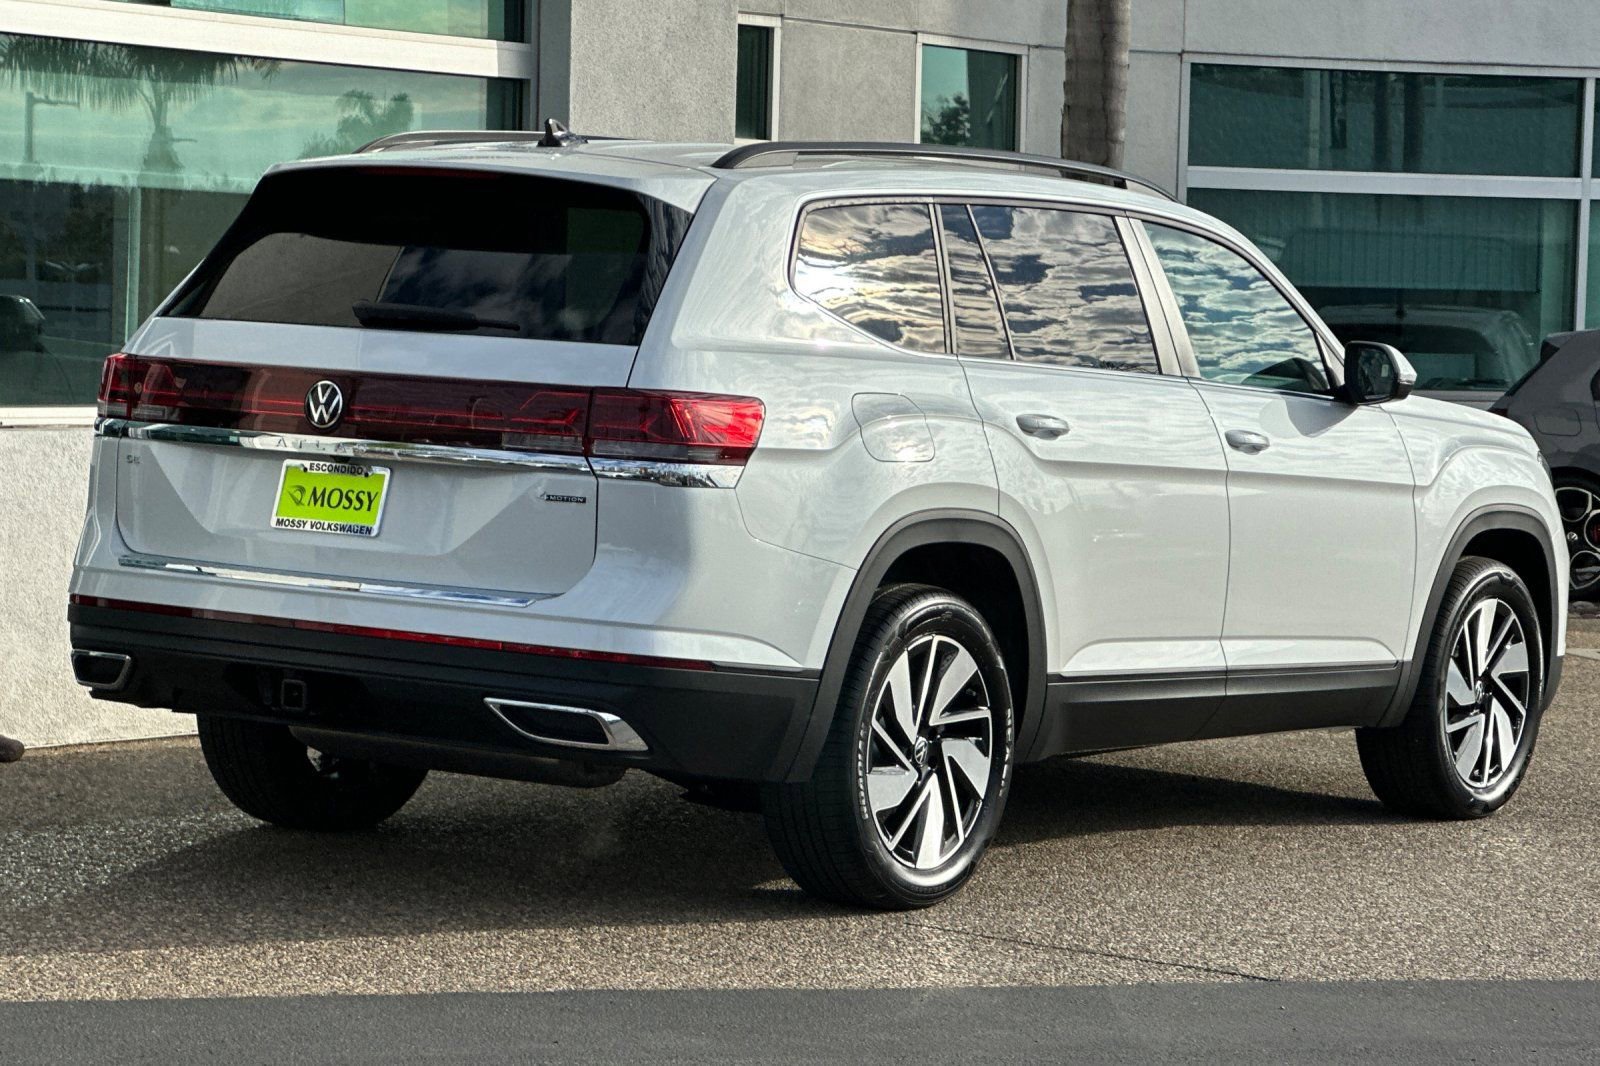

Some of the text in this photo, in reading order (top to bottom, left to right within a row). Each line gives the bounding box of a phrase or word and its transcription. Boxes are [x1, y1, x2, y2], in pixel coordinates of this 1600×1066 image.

[309, 463, 364, 475] ESCONDIDO
[307, 486, 379, 512] MOSSY
[275, 518, 373, 535] MOSSY VOLKSWAGEN
